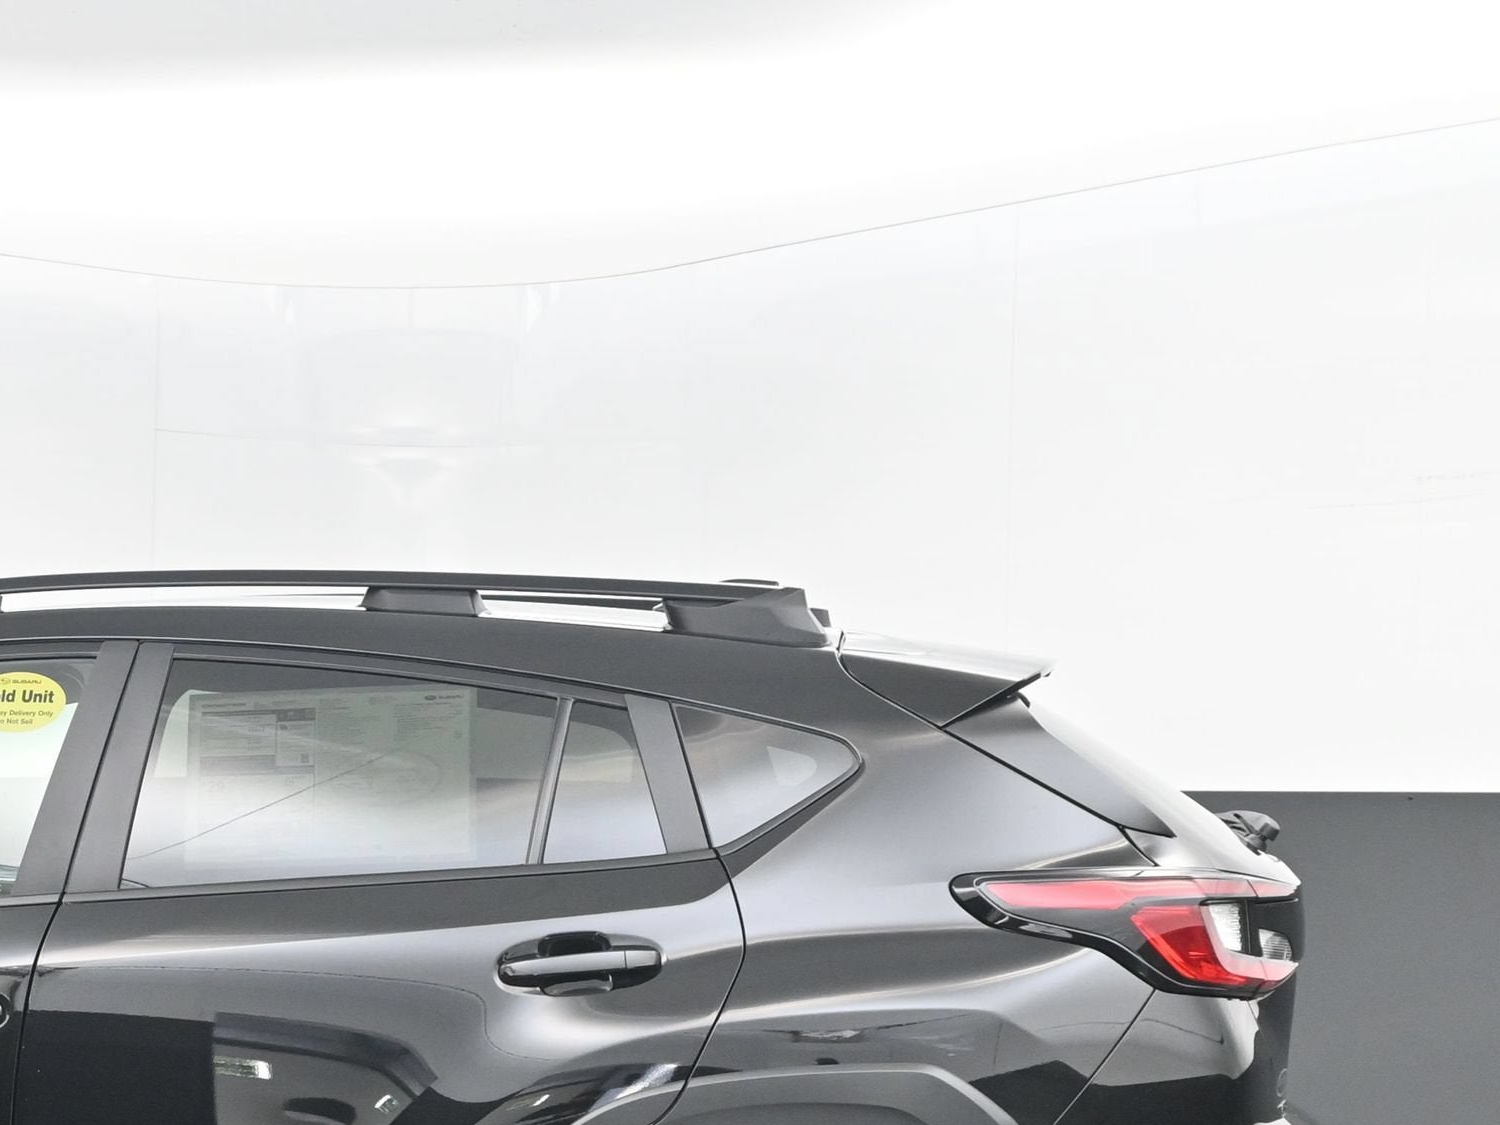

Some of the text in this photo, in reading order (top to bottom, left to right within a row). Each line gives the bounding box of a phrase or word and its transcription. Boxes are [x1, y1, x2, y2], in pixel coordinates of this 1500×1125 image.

[21, 689, 55, 704] Unit
[9, 709, 36, 717] Delivery
[38, 710, 54, 718] Only
